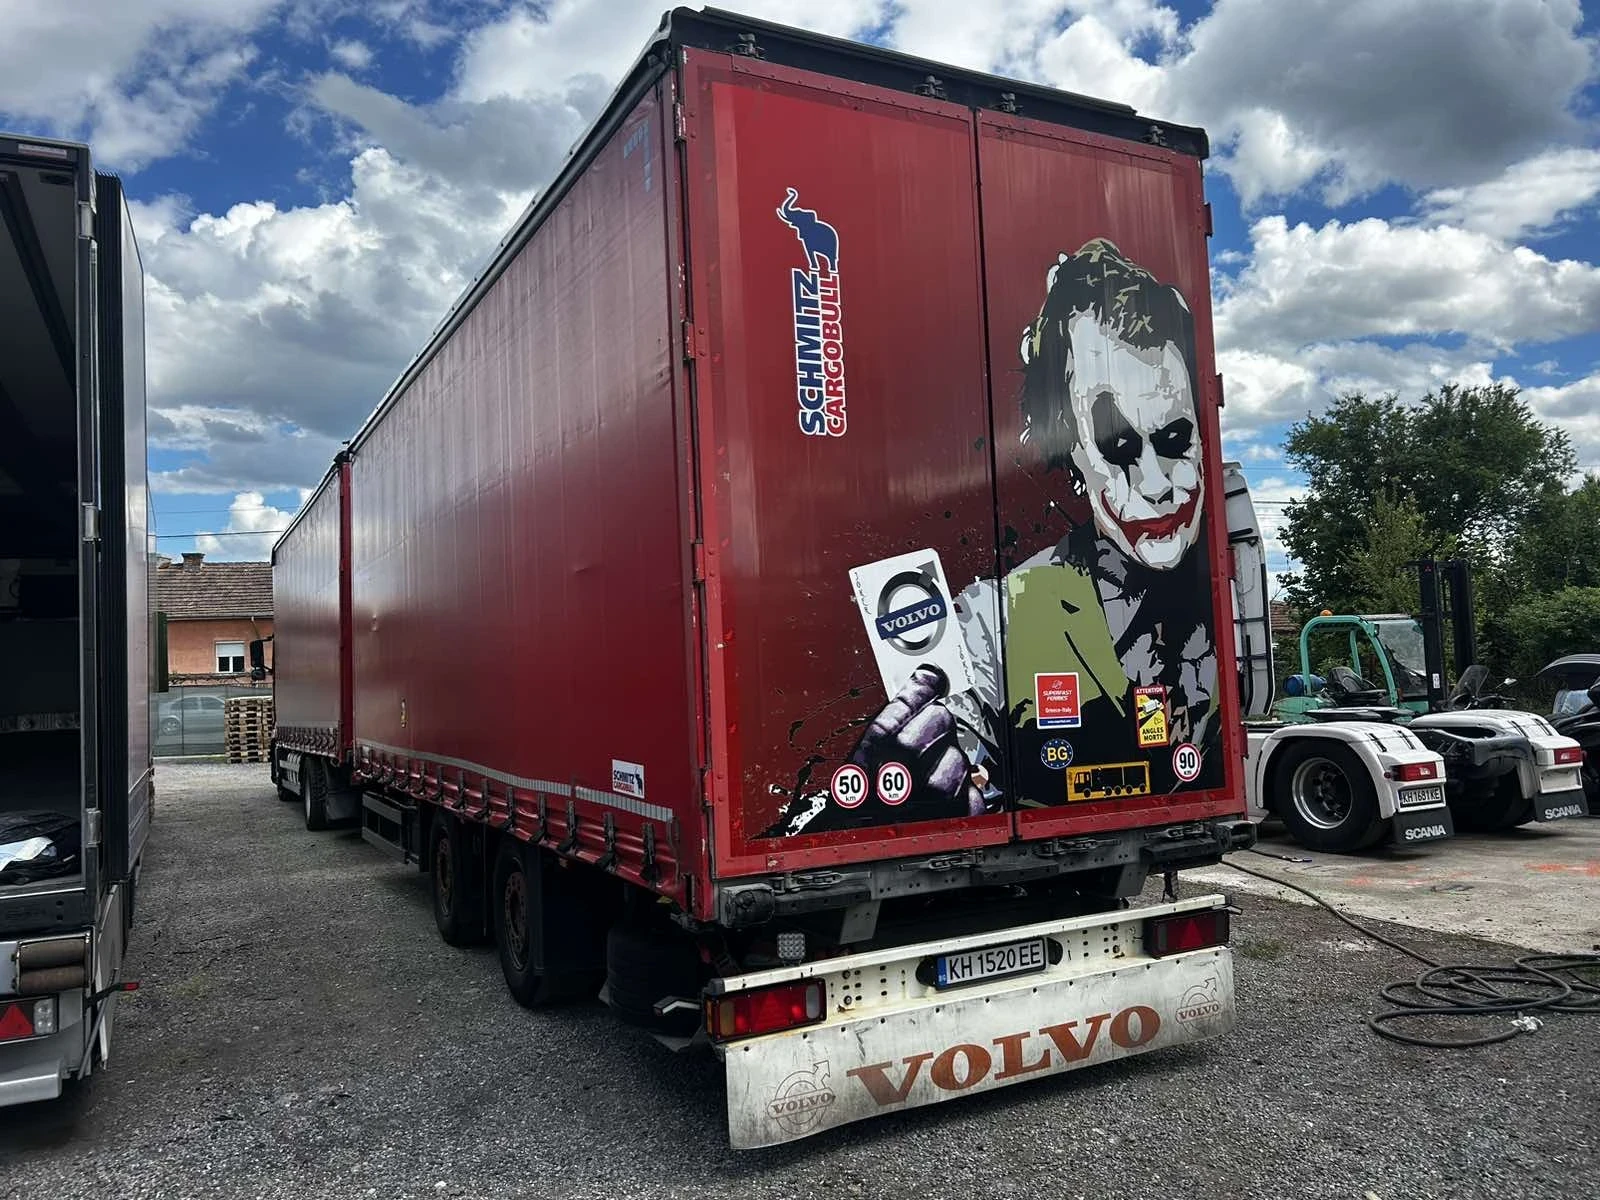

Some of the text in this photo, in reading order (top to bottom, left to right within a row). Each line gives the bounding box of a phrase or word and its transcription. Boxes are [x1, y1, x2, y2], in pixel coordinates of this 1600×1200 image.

[792, 268, 826, 436] SCHMITZ
[819, 272, 847, 437] CARGOBULL
[881, 603, 941, 633] VOLVO
[1042, 689, 1072, 697] SUPERFAST
[1142, 727, 1163, 735] ANGLES
[1047, 746, 1068, 761] BG
[1179, 752, 1195, 769] 90
[839, 774, 861, 795] 50
[883, 772, 904, 791] 60
[1544, 804, 1582, 820] SCANIA
[1405, 824, 1446, 840] SCANIA
[949, 943, 1041, 981] KH 1520 EE
[1178, 1003, 1219, 1020] VOLVO
[846, 1005, 1161, 1106] VOLVO
[771, 1092, 832, 1113] VOLVO
